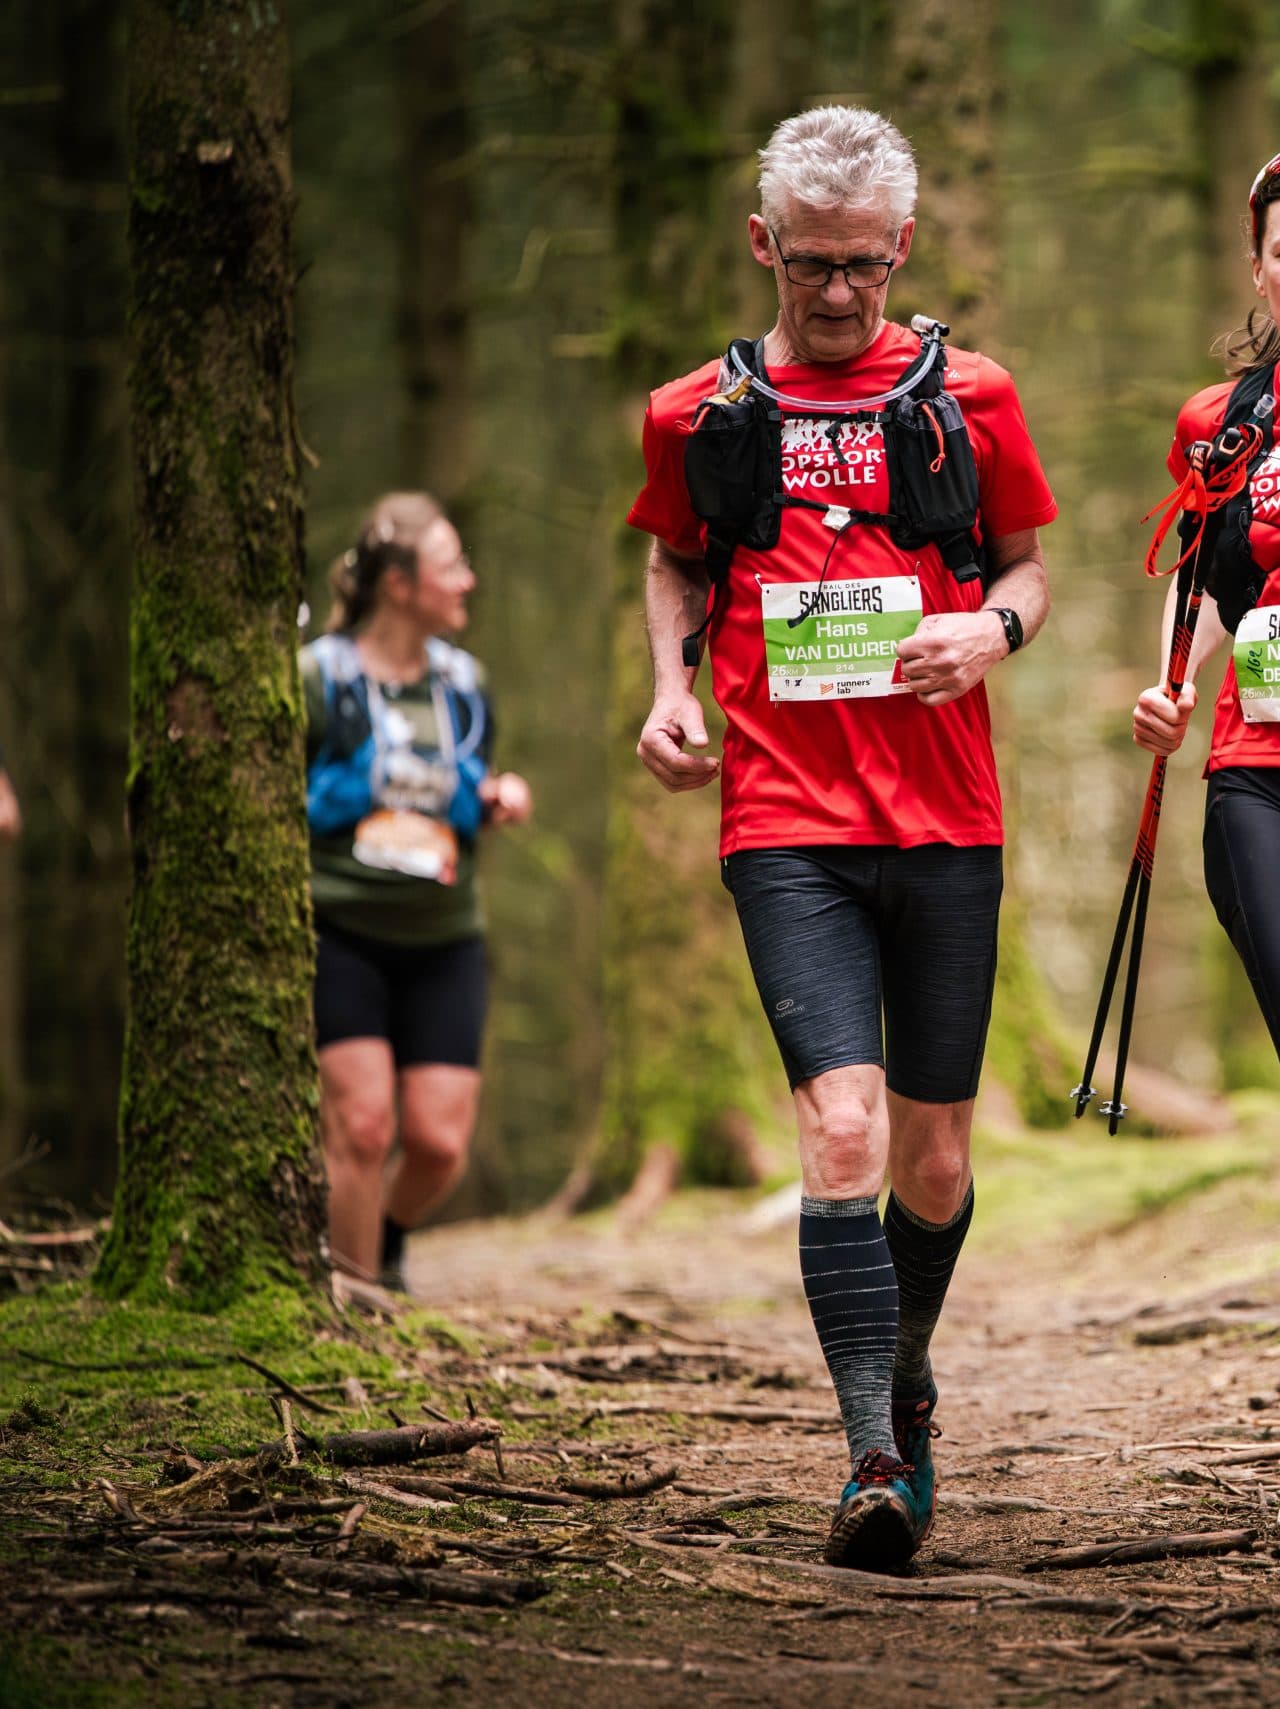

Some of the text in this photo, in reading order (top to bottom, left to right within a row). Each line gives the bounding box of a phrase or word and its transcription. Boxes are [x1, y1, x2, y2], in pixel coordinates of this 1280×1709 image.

[782, 466, 876, 490] WOLLE
[816, 621, 868, 638] Hans
[785, 645, 821, 661] VAN
[835, 664, 855, 672] 214
